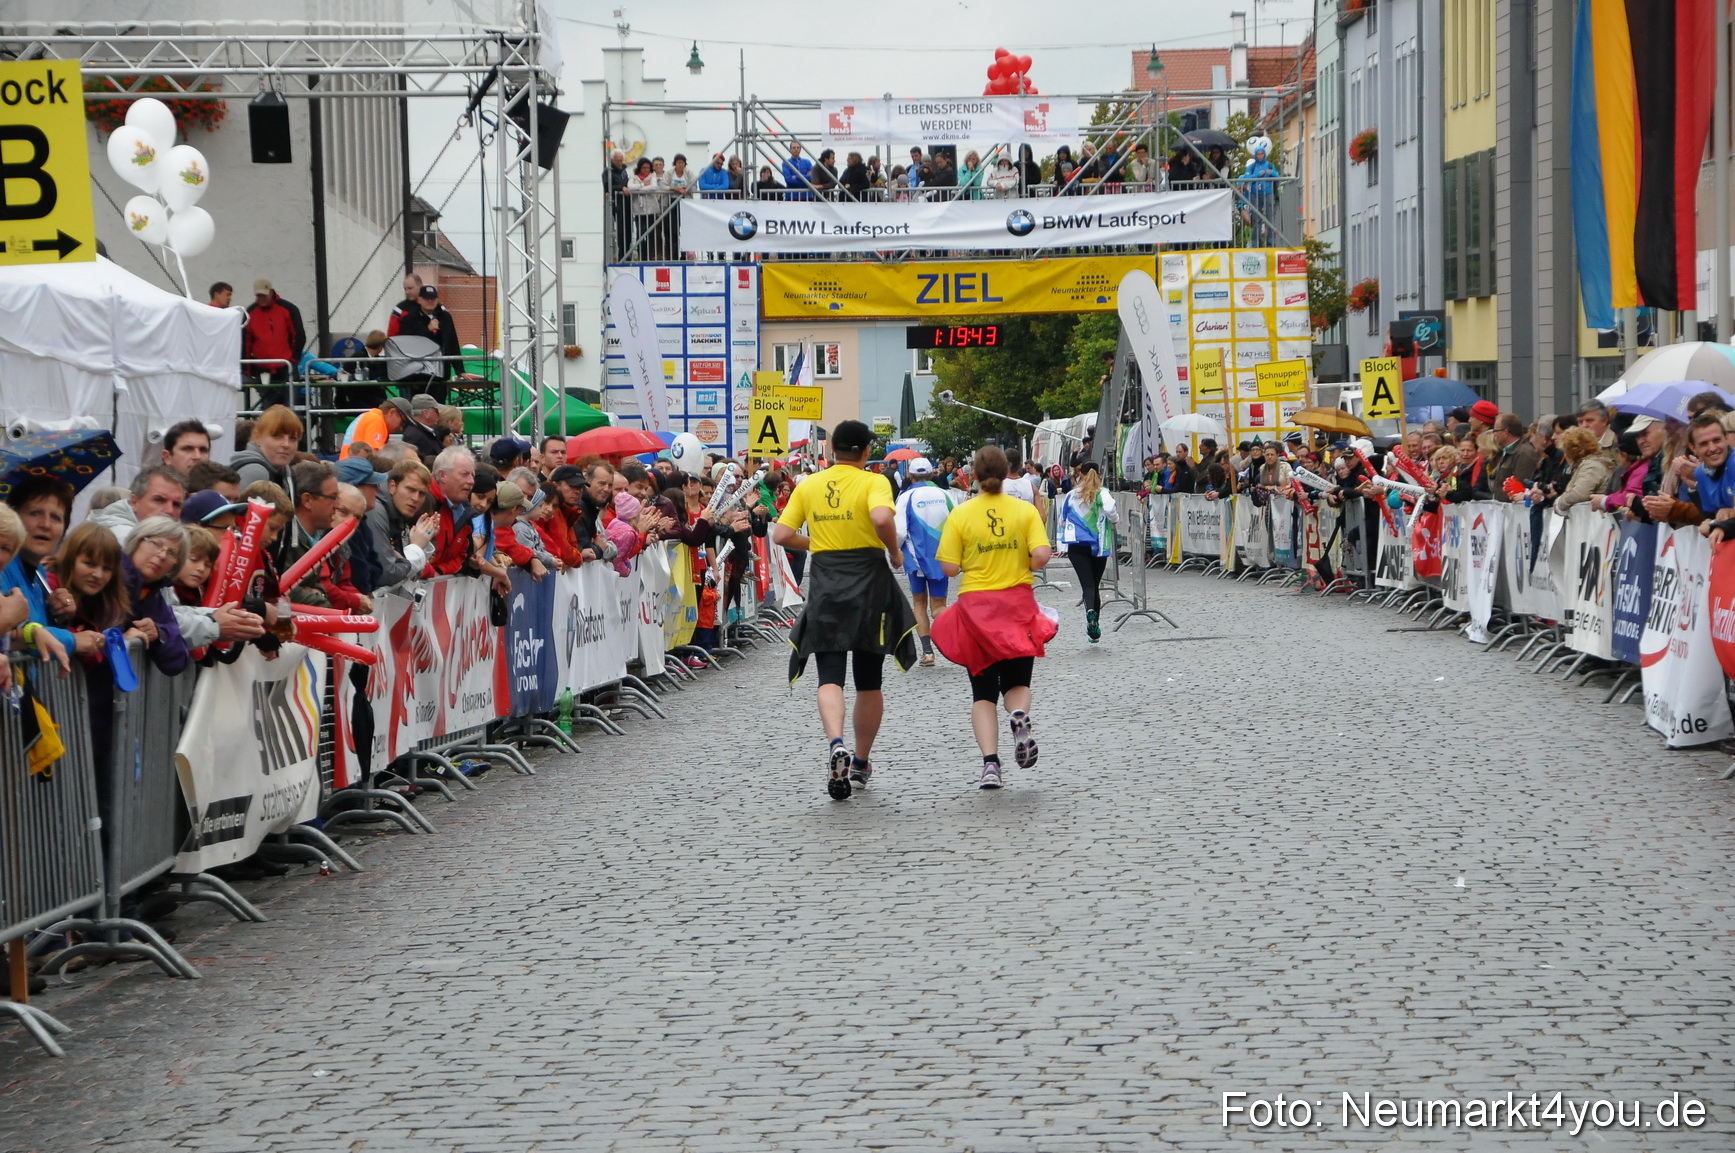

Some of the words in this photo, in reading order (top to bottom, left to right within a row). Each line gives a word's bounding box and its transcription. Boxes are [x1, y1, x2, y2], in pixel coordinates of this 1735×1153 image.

[0, 69, 68, 105] ock
[898, 103, 993, 115] LEBENSSPENDER
[830, 127, 851, 135] DKMS
[920, 119, 972, 131] WERDEN!
[1025, 124, 1046, 132] DKMS
[922, 133, 970, 141] www.dkms.de
[0, 124, 58, 221] B
[1043, 214, 1092, 229] BMW
[1098, 210, 1186, 229] Laufsport
[765, 219, 816, 235] BMW
[820, 220, 910, 238] Laufsport
[916, 272, 1003, 304] ZIEL
[1051, 286, 1097, 294] Neumarkter
[1098, 284, 1119, 292] Stadt
[783, 291, 829, 299] Neumarkter
[831, 291, 867, 299] Stadtlauf
[690, 306, 721, 315] Xplus1
[1196, 320, 1229, 332] Charivari
[1279, 320, 1309, 329] Xplus1
[935, 326, 997, 347] 1:19:43
[1237, 350, 1271, 358] NATHUS
[1195, 361, 1222, 370] Jugend
[1364, 360, 1397, 373] Block
[1203, 369, 1218, 378] lauf
[1258, 370, 1304, 380] Schnupper-
[1275, 380, 1289, 388] lauf
[1371, 376, 1395, 406] A
[754, 399, 785, 411] Block
[789, 395, 820, 404] nupper-
[789, 404, 804, 412] lauf
[757, 415, 780, 444] A
[812, 511, 841, 522] Neunkirchen
[240, 511, 262, 553] Audi
[977, 542, 1007, 554] Neunkirchen
[229, 555, 250, 592] BKK
